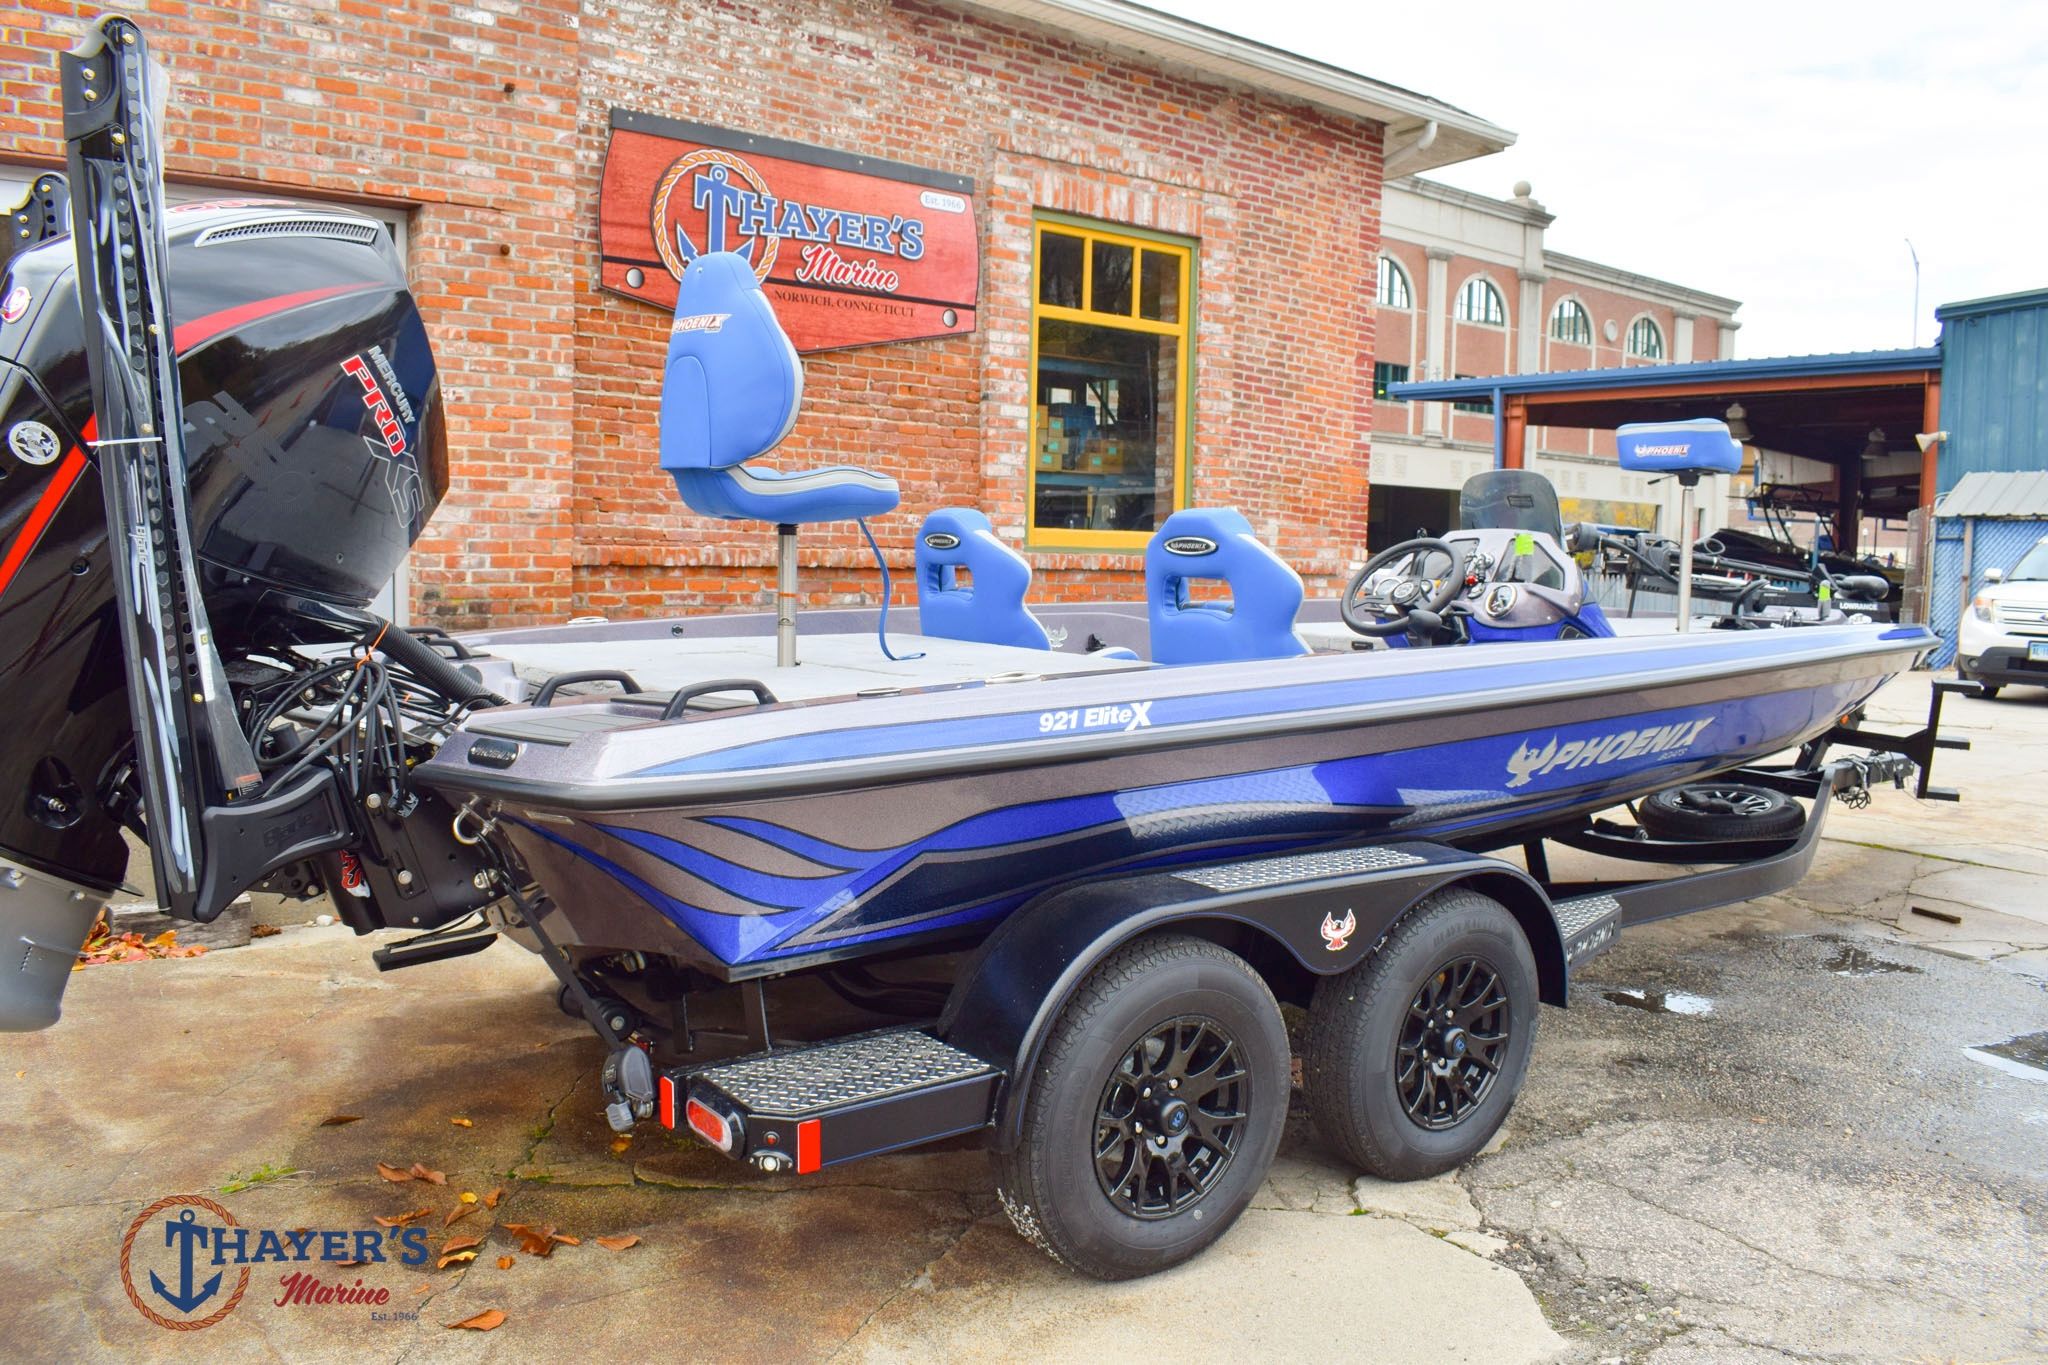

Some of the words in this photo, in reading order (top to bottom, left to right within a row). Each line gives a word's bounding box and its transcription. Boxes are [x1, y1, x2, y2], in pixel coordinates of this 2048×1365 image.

[684, 165, 924, 261] THAYER'S
[797, 244, 899, 292] Marine
[774, 290, 834, 308] NORWICH,
[836, 299, 916, 318] CONNECTICUT
[340, 354, 407, 457] PRO
[368, 345, 415, 424] MERCURY
[1839, 602, 1879, 611] LOWRANCE
[1039, 711, 1079, 733] 921
[1538, 716, 1716, 776] PHOENIX
